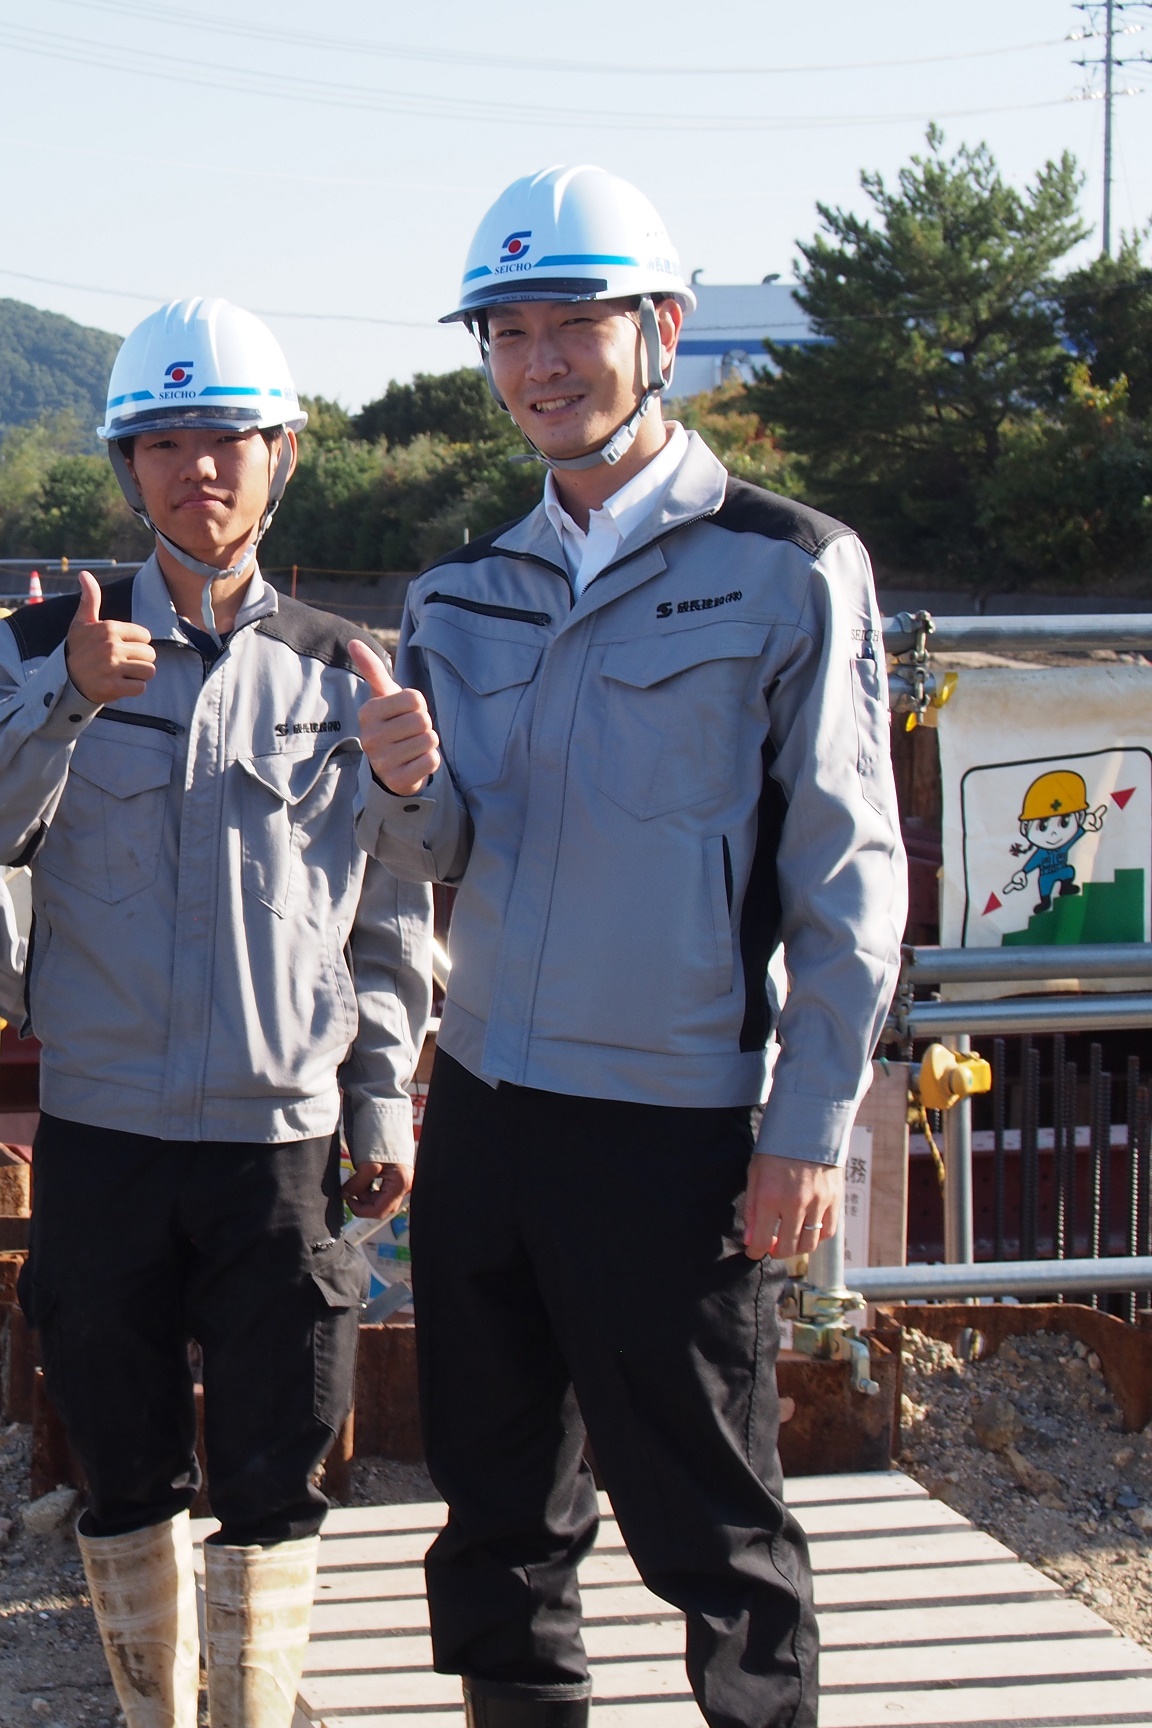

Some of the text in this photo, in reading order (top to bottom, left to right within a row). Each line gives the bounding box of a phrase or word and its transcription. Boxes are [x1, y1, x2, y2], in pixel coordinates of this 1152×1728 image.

[494, 262, 532, 275] SEICHO
[159, 390, 196, 400] SEICHO
[851, 629, 882, 641] SEICH
